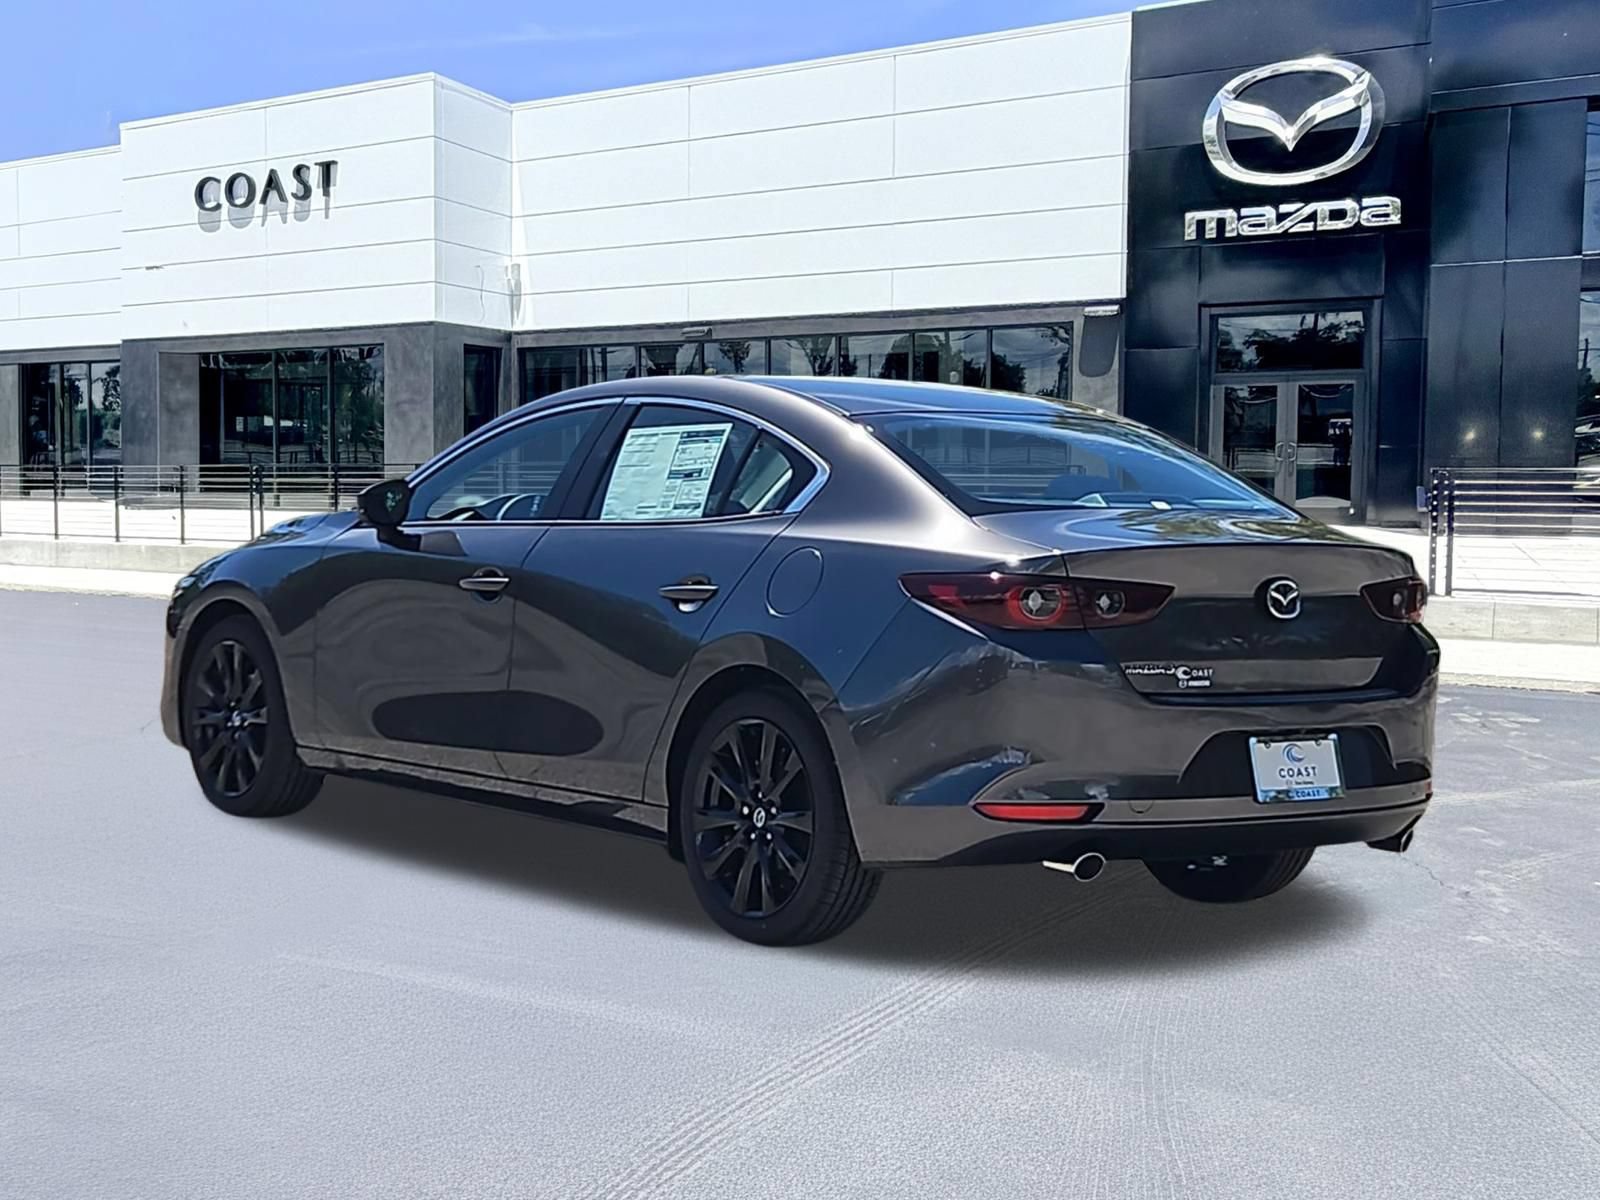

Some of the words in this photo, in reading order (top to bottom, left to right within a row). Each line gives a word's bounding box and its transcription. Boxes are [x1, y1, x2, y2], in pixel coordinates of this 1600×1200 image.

[194, 160, 338, 212] COAST
[1279, 766, 1317, 778] COAST
[1296, 789, 1320, 798] COAST
